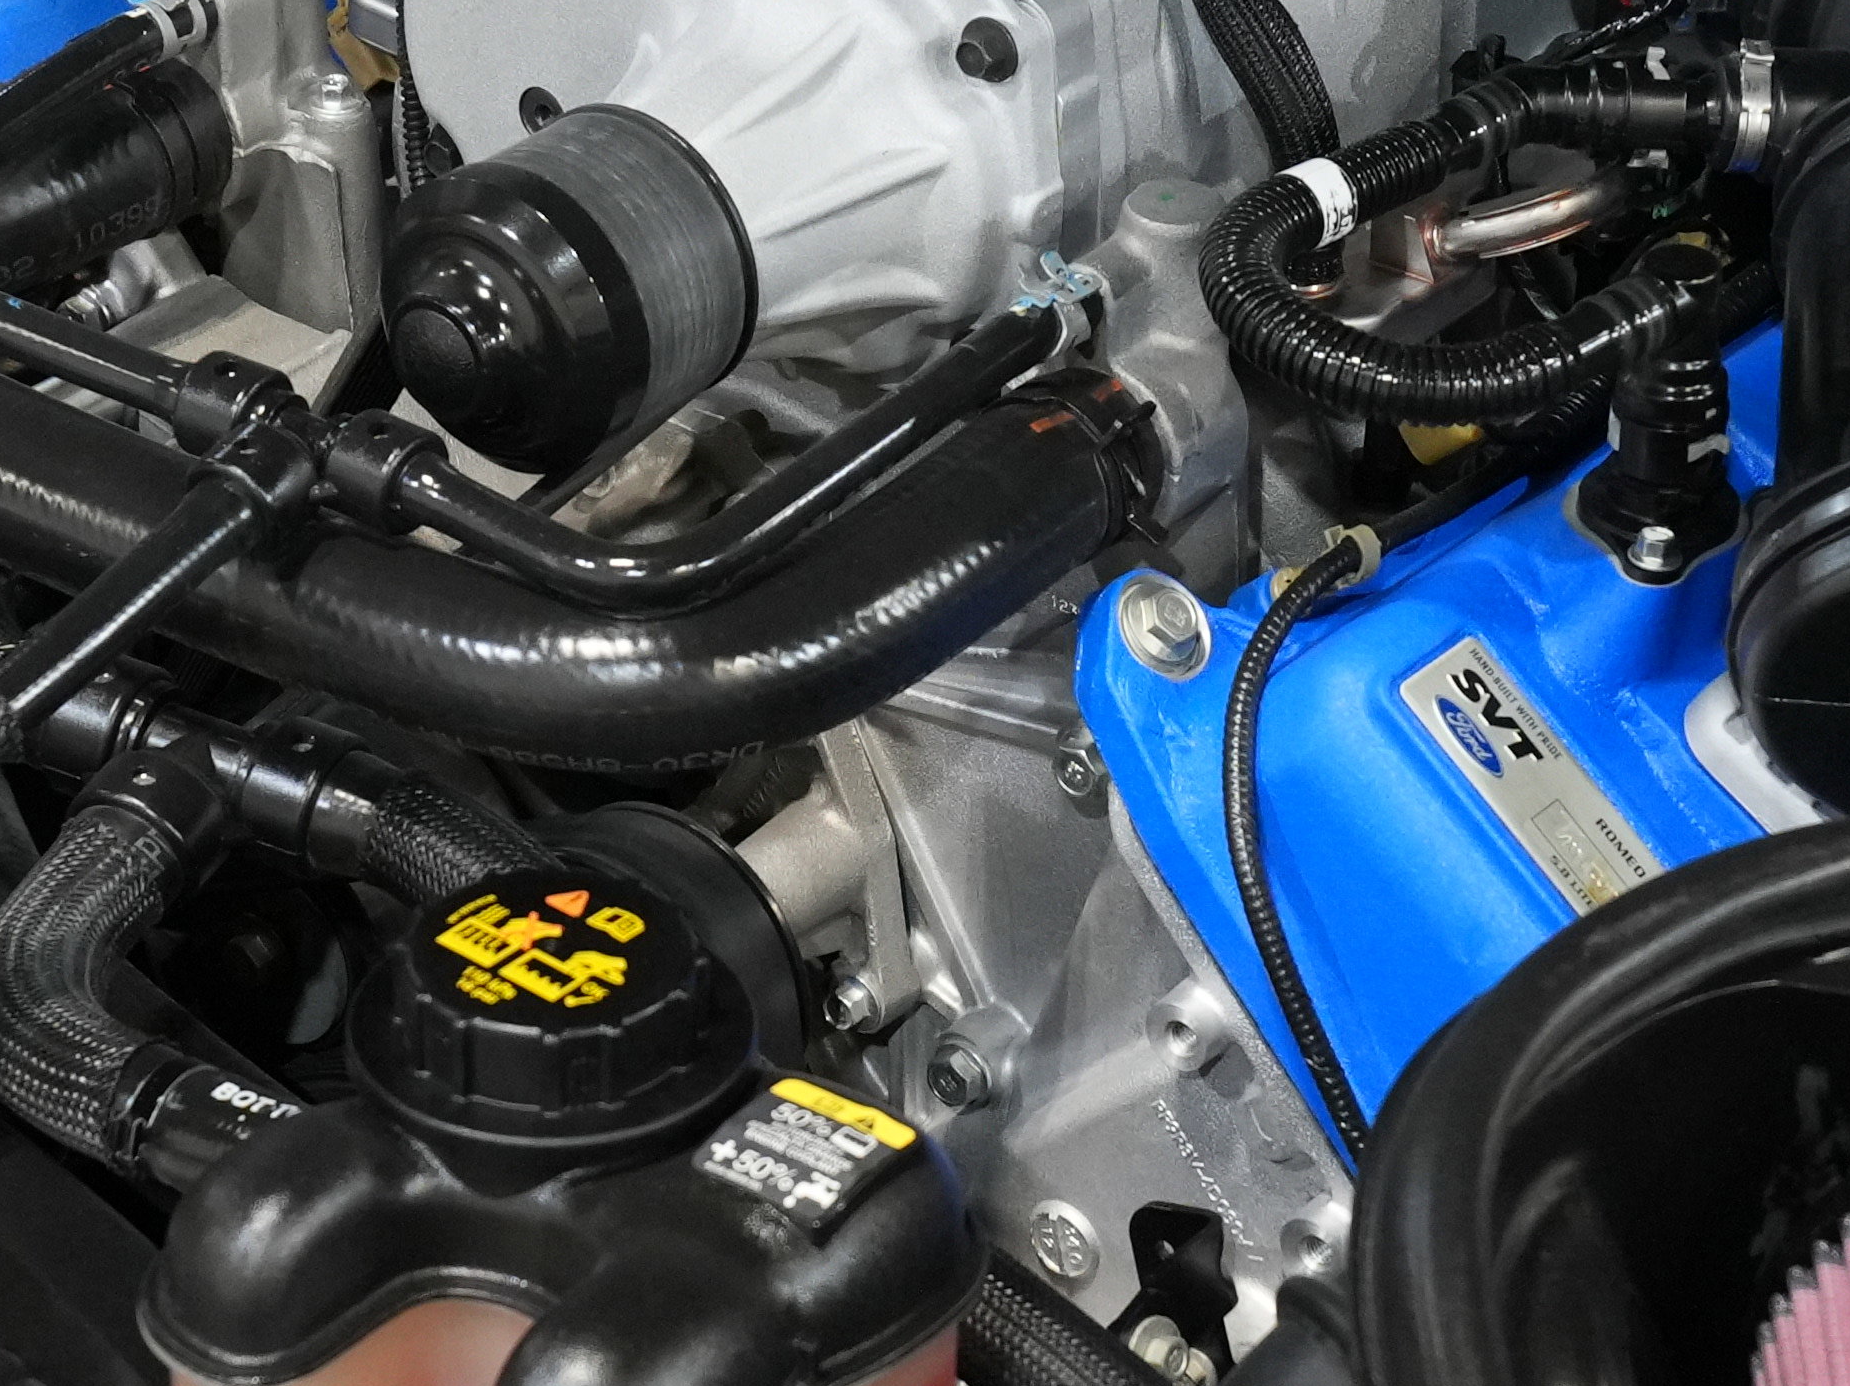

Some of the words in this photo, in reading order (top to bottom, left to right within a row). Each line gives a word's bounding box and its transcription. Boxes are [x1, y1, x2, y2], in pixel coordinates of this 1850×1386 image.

[1442, 707, 1499, 765] Ford
[1449, 668, 1544, 763] SVT
[1516, 704, 1539, 732] WITH
[1536, 730, 1563, 760] PRIDE
[1594, 817, 1646, 879] ROMEO
[770, 1102, 834, 1138] 50%
